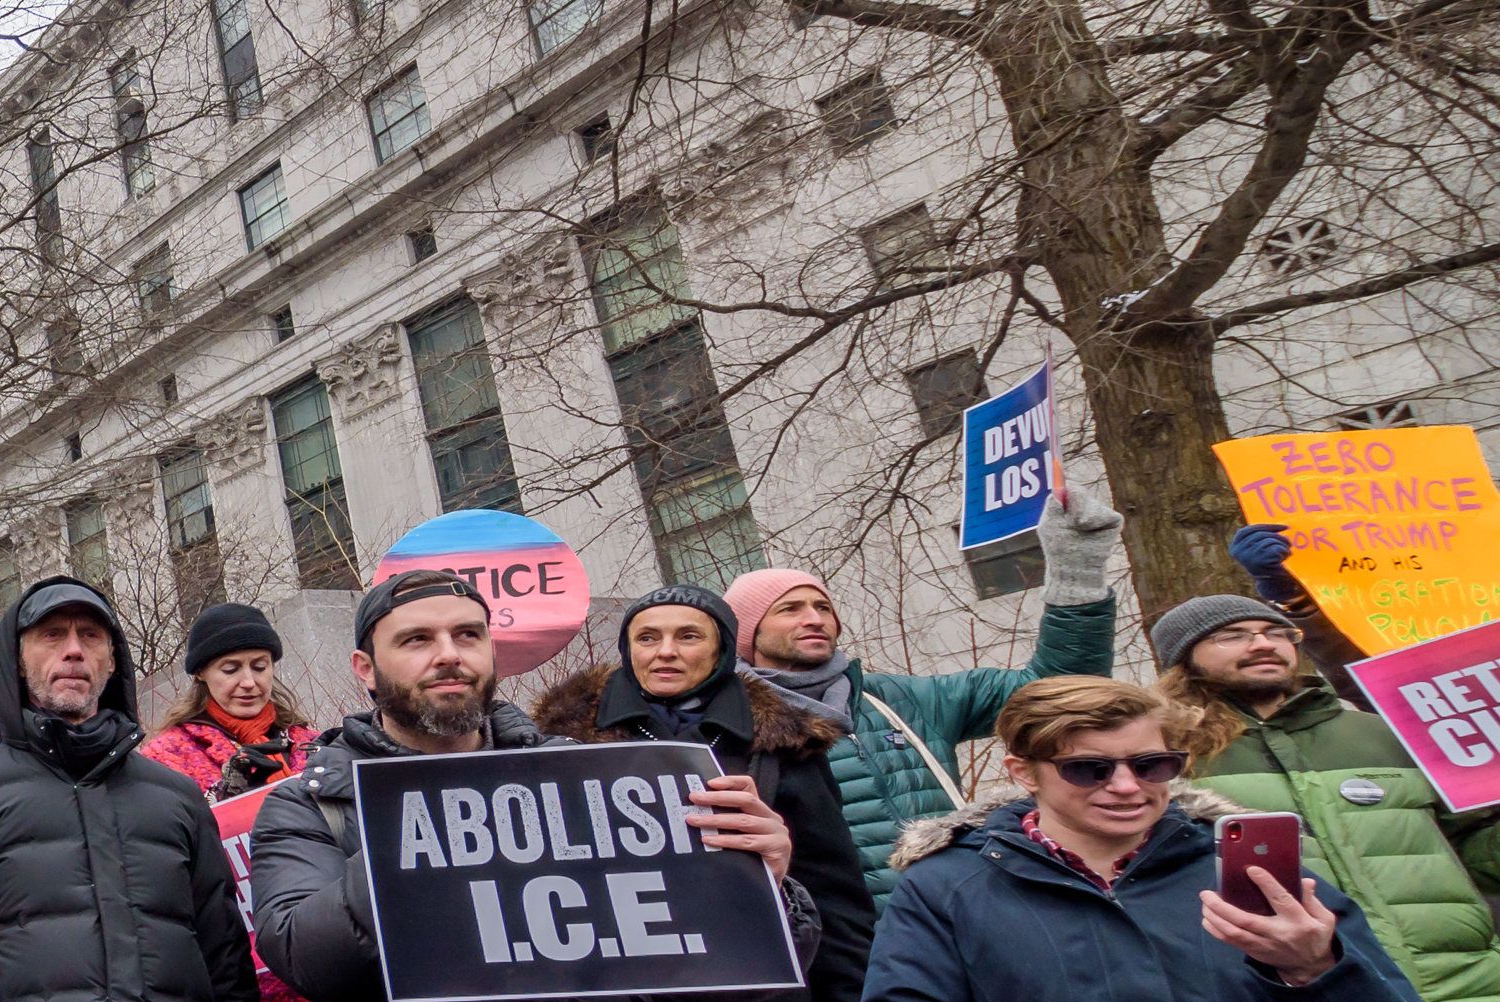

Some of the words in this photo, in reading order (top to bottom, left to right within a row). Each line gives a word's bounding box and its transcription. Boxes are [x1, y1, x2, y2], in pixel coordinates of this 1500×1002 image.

[984, 397, 1050, 465] DEVU
[1271, 439, 1396, 476] ZERO
[985, 458, 1041, 512] LOS
[1241, 476, 1482, 518] TOLERANCE
[1288, 526, 1340, 552] OR
[1341, 520, 1460, 552] TRUMP
[1338, 556, 1377, 573] AND
[1393, 554, 1424, 571] HIS
[1398, 659, 1500, 723] RET
[399, 774, 724, 870] ABOLISH
[470, 871, 707, 964] I.C.E.
